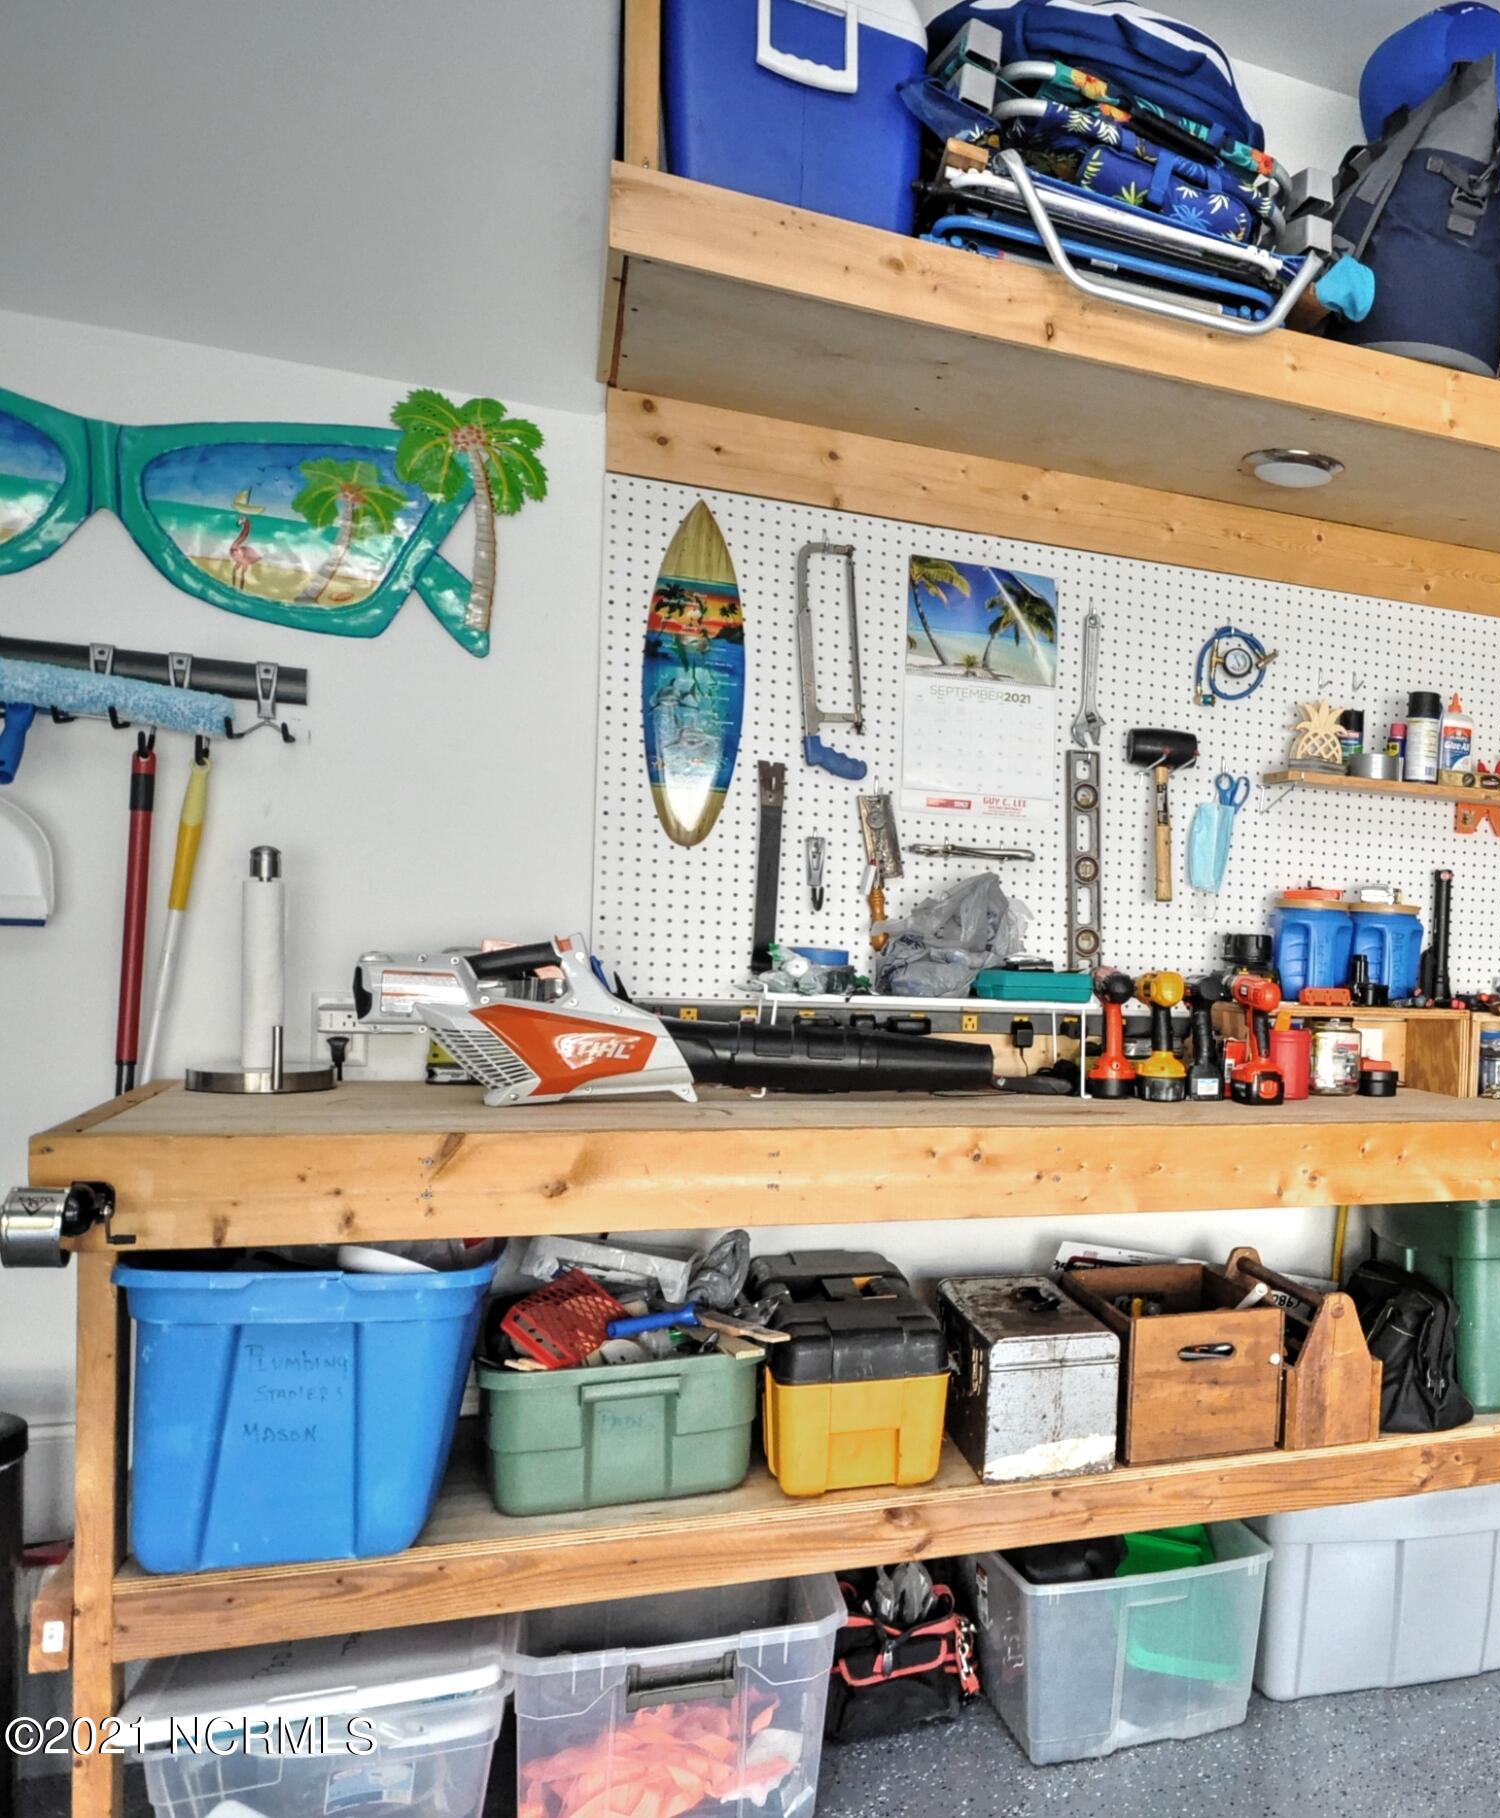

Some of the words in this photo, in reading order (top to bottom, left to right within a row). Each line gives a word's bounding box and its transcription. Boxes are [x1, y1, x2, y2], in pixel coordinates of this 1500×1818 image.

[930, 685, 1003, 702] SEPTEMBER
[1003, 692, 1032, 705] 2021
[243, 1423, 317, 1443] MASON
